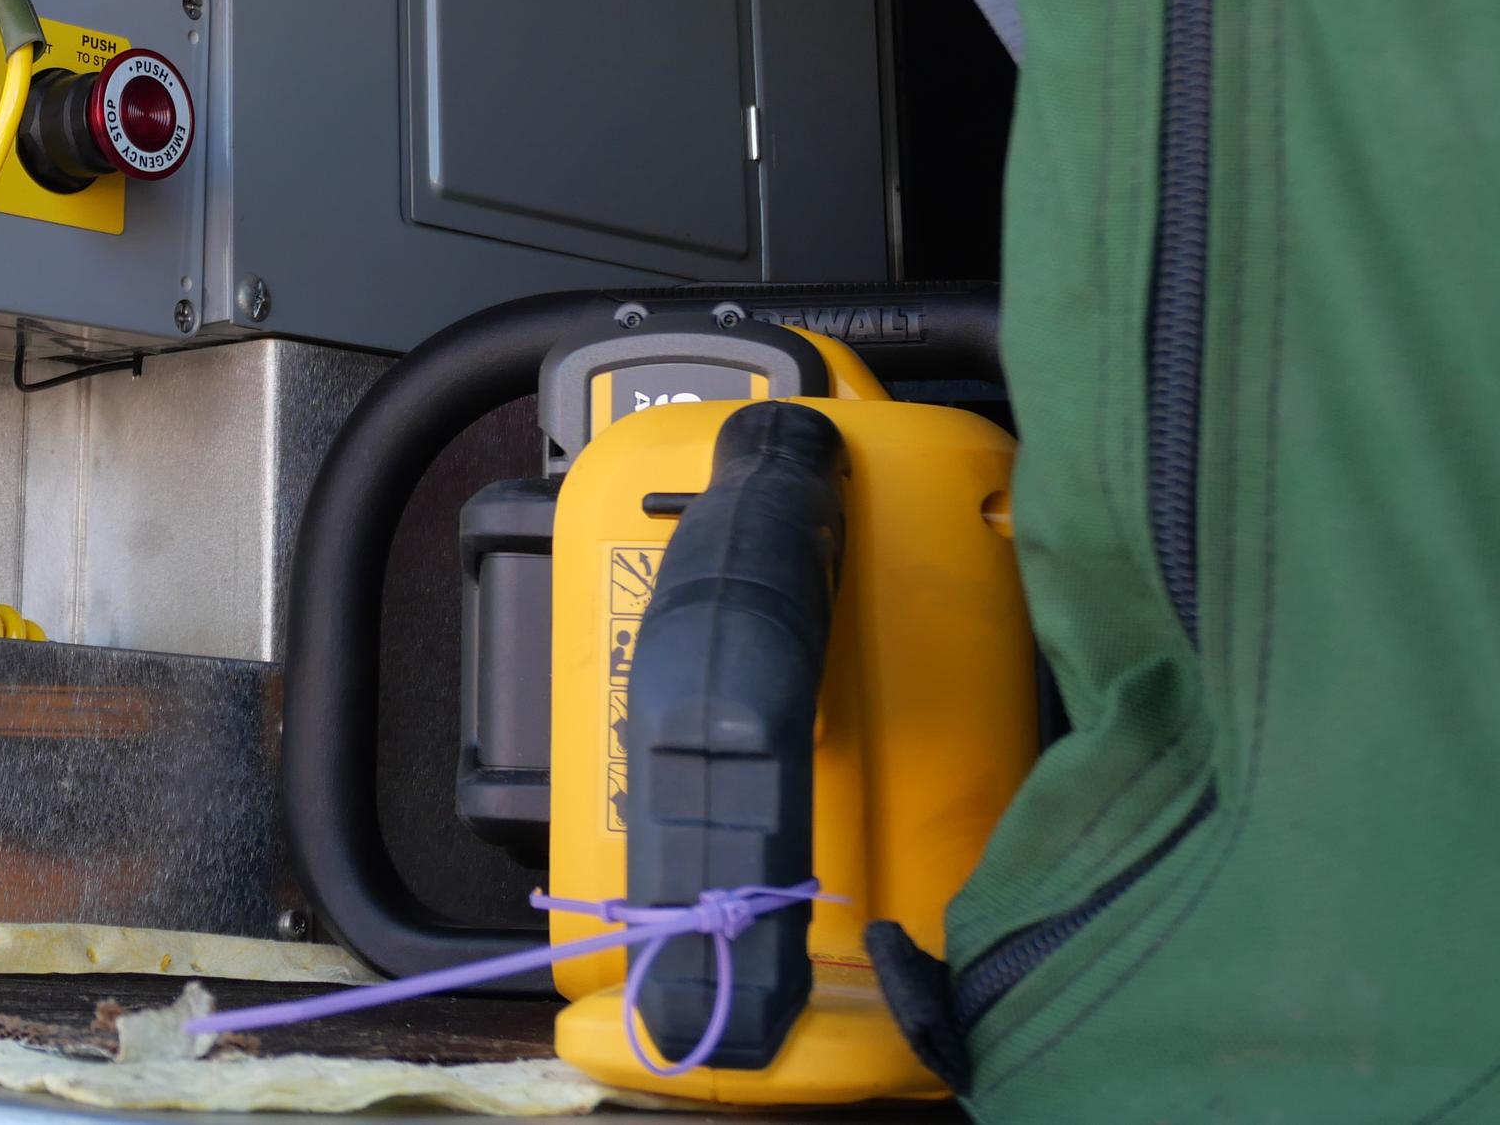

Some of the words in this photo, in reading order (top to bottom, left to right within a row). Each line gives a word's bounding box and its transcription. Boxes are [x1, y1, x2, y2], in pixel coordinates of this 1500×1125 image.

[81, 34, 117, 54] PUSH
[76, 51, 90, 64] TO
[93, 55, 111, 68] ST
[135, 59, 170, 82] PUSH
[106, 99, 123, 144] STOP
[121, 124, 187, 169] EMERGENCY
